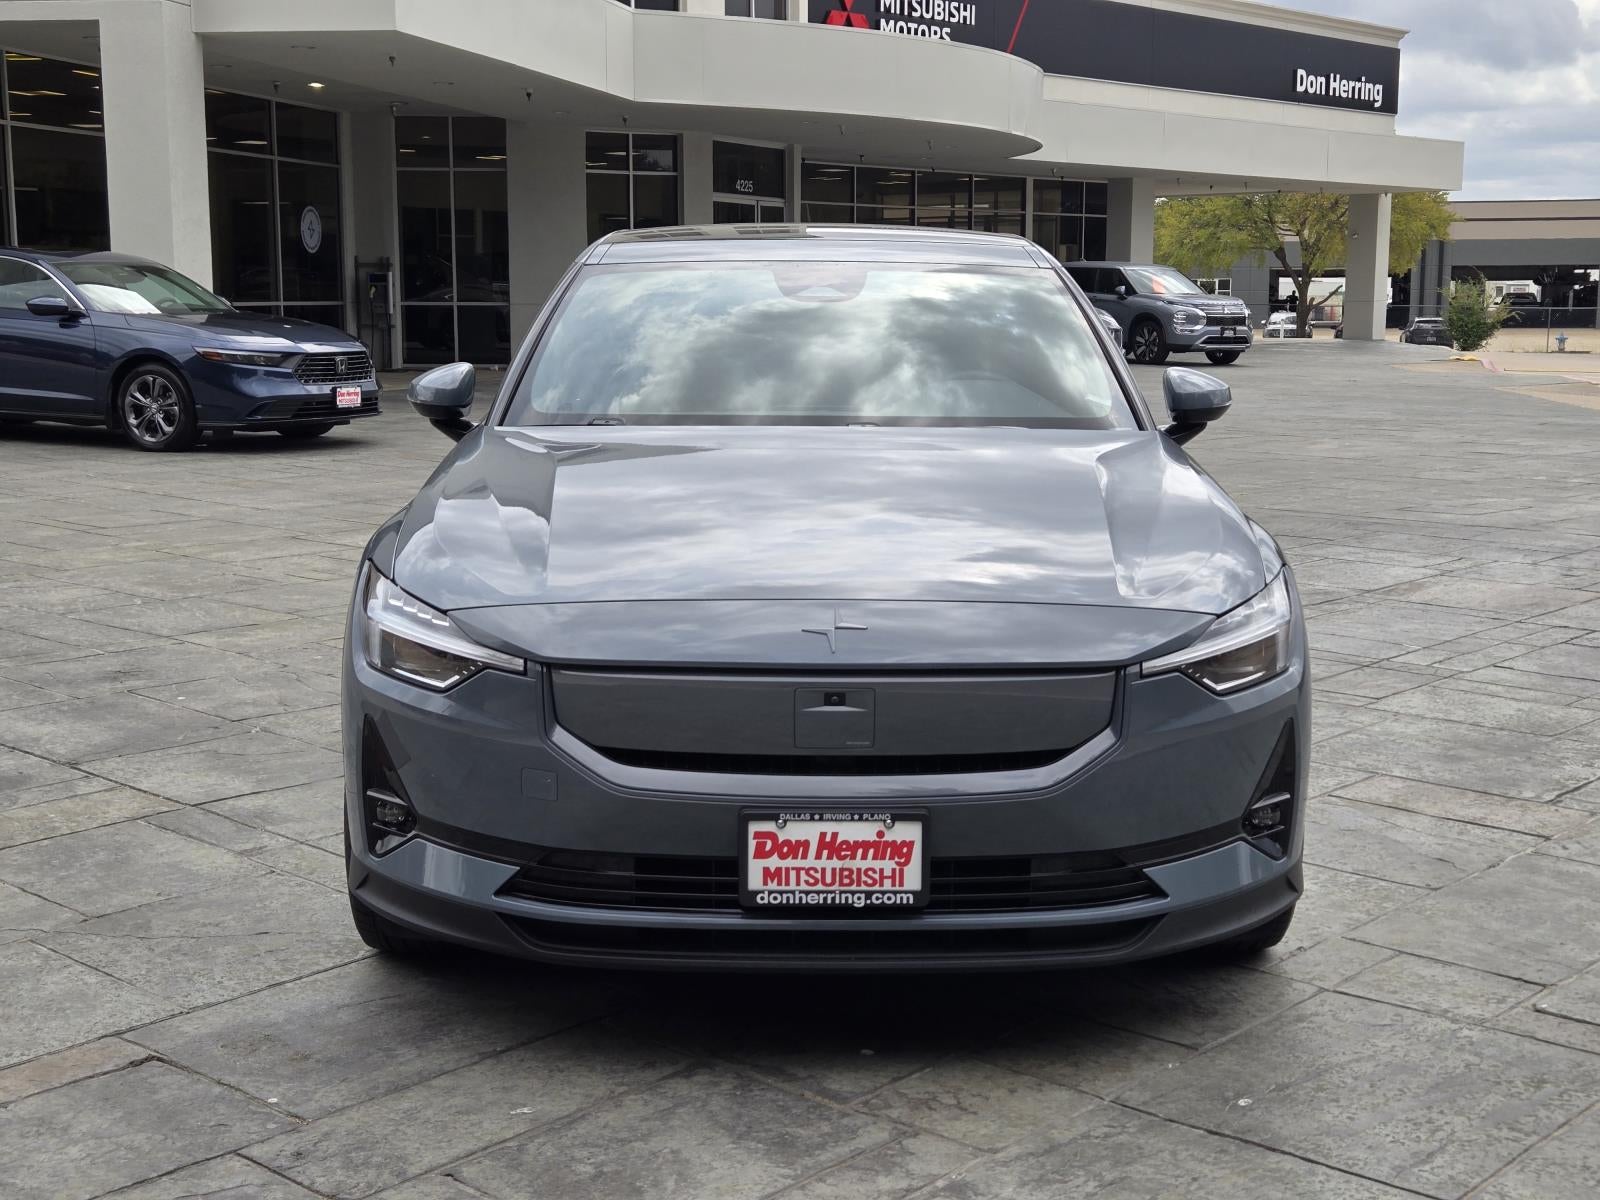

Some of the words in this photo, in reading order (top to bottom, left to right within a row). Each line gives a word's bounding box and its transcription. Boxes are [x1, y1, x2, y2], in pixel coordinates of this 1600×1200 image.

[880, 0, 976, 26] MITSUBISHI
[880, 18, 952, 41] MOTORS
[1296, 68, 1326, 95] Don
[1329, 73, 1383, 108] Herring
[736, 179, 754, 192] 4225
[752, 830, 811, 860] Don
[814, 829, 916, 868] Herring
[762, 866, 905, 888] MITSUBISHI
[756, 891, 914, 908] donherring.com
